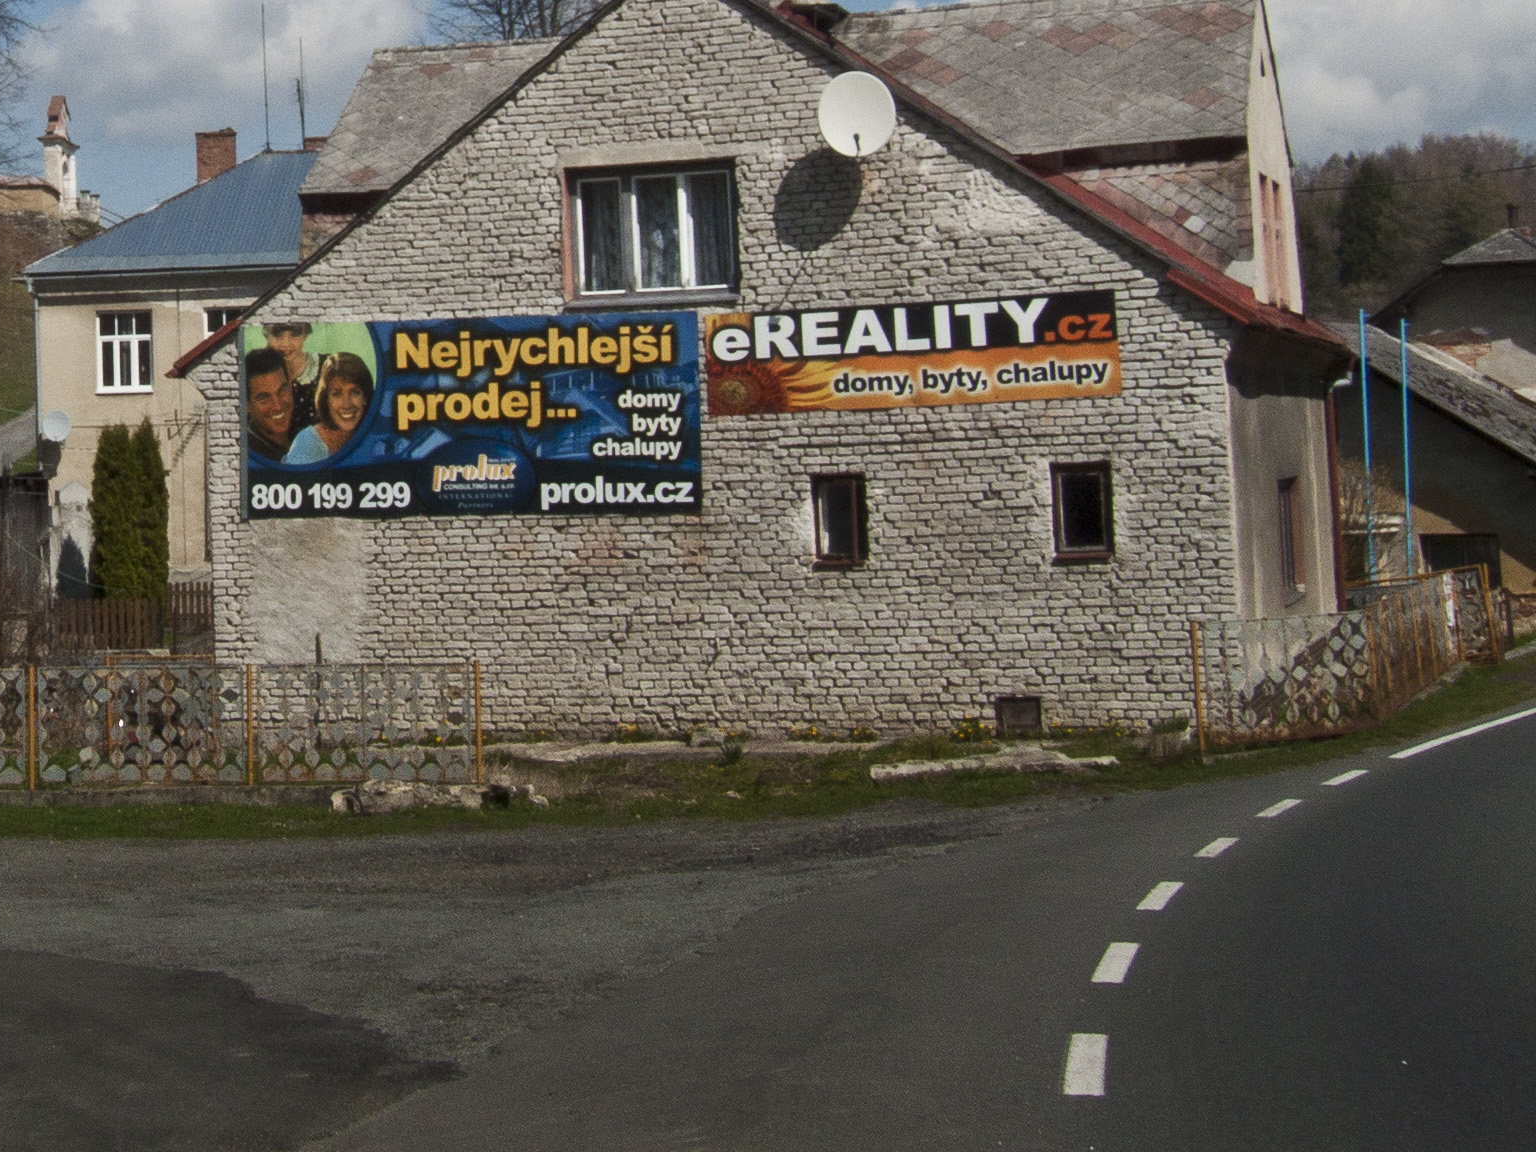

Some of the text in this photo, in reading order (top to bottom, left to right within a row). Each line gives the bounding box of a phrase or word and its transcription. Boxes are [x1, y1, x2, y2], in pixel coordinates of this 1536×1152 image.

[712, 297, 1113, 362] eREALITY.cz
[395, 324, 673, 377] Nejrychlejší
[833, 360, 1108, 396] domy, byty, chalupy
[397, 381, 577, 431] prodej...
[618, 389, 681, 412] domy
[632, 413, 682, 436] byty
[592, 437, 682, 460] chalupy
[432, 454, 517, 492] prolux
[251, 481, 411, 510] 800 199 299
[540, 475, 694, 510] prolux.cz
